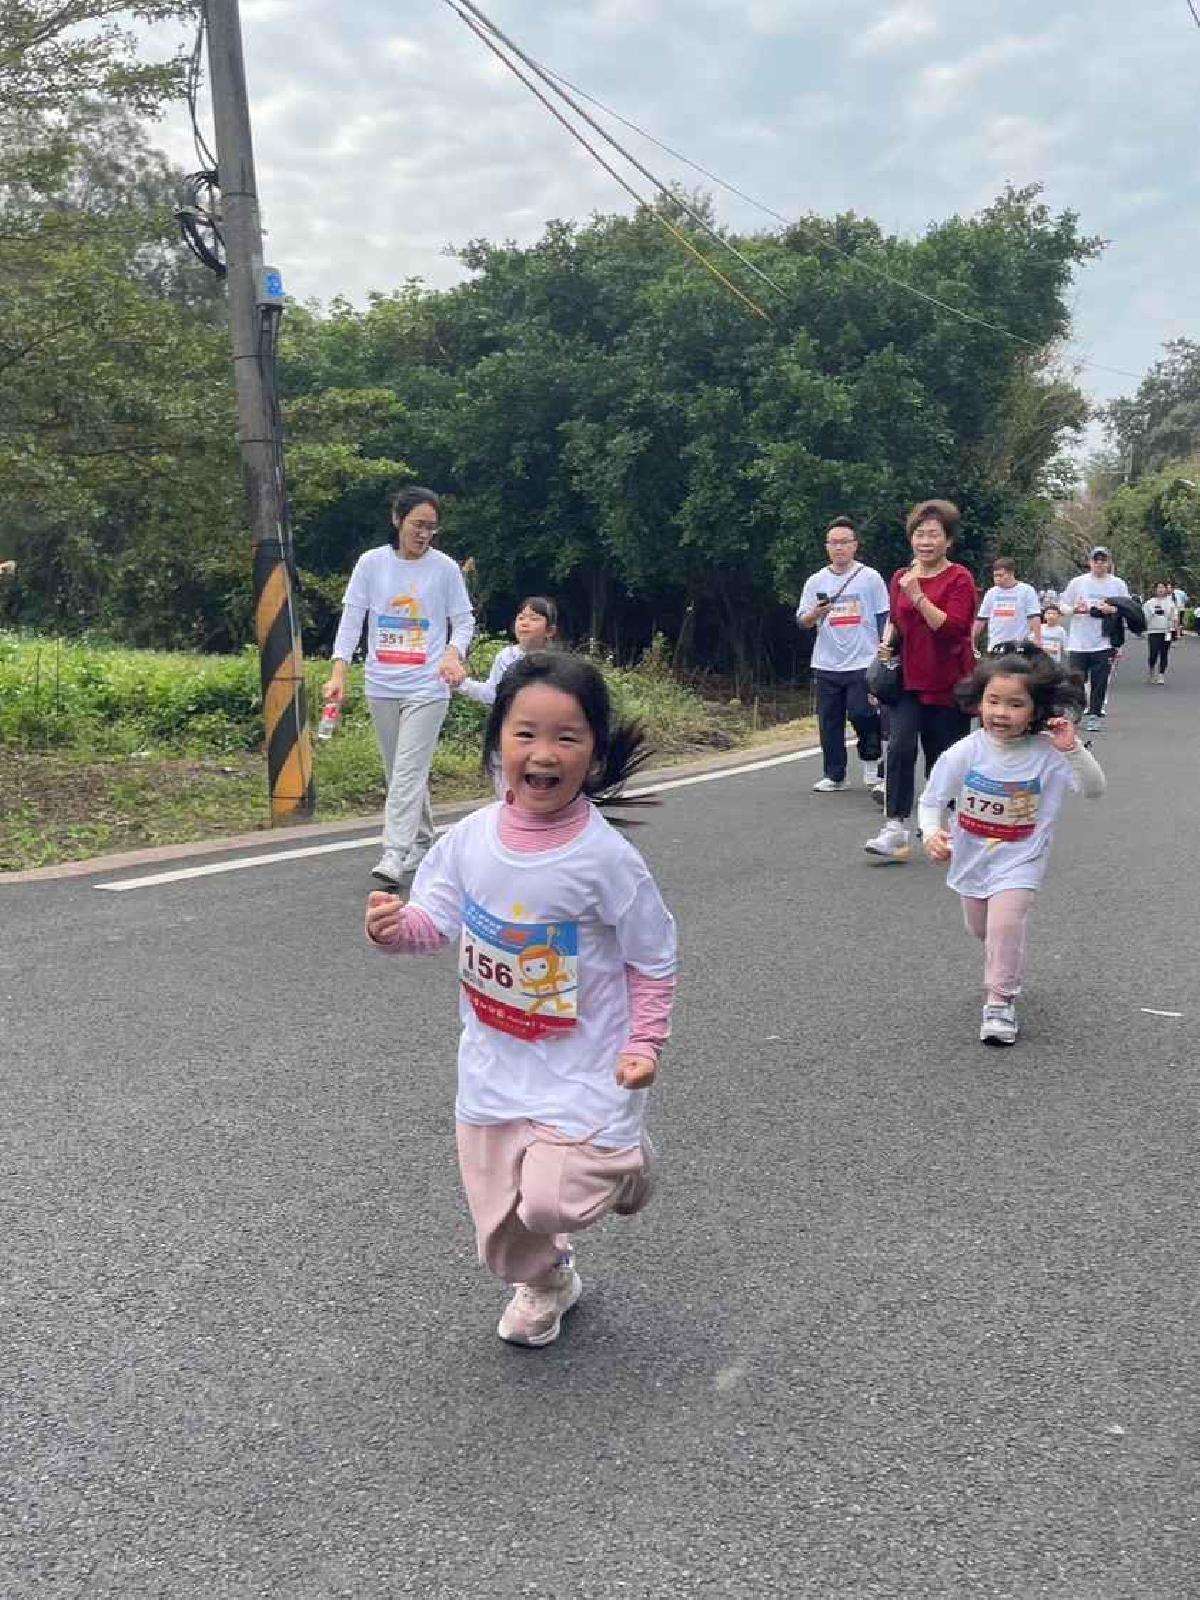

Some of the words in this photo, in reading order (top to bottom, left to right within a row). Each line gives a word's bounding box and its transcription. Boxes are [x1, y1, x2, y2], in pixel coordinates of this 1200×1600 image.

[379, 633, 404, 645] 351
[966, 796, 1004, 816] 179
[464, 945, 513, 988] 156
